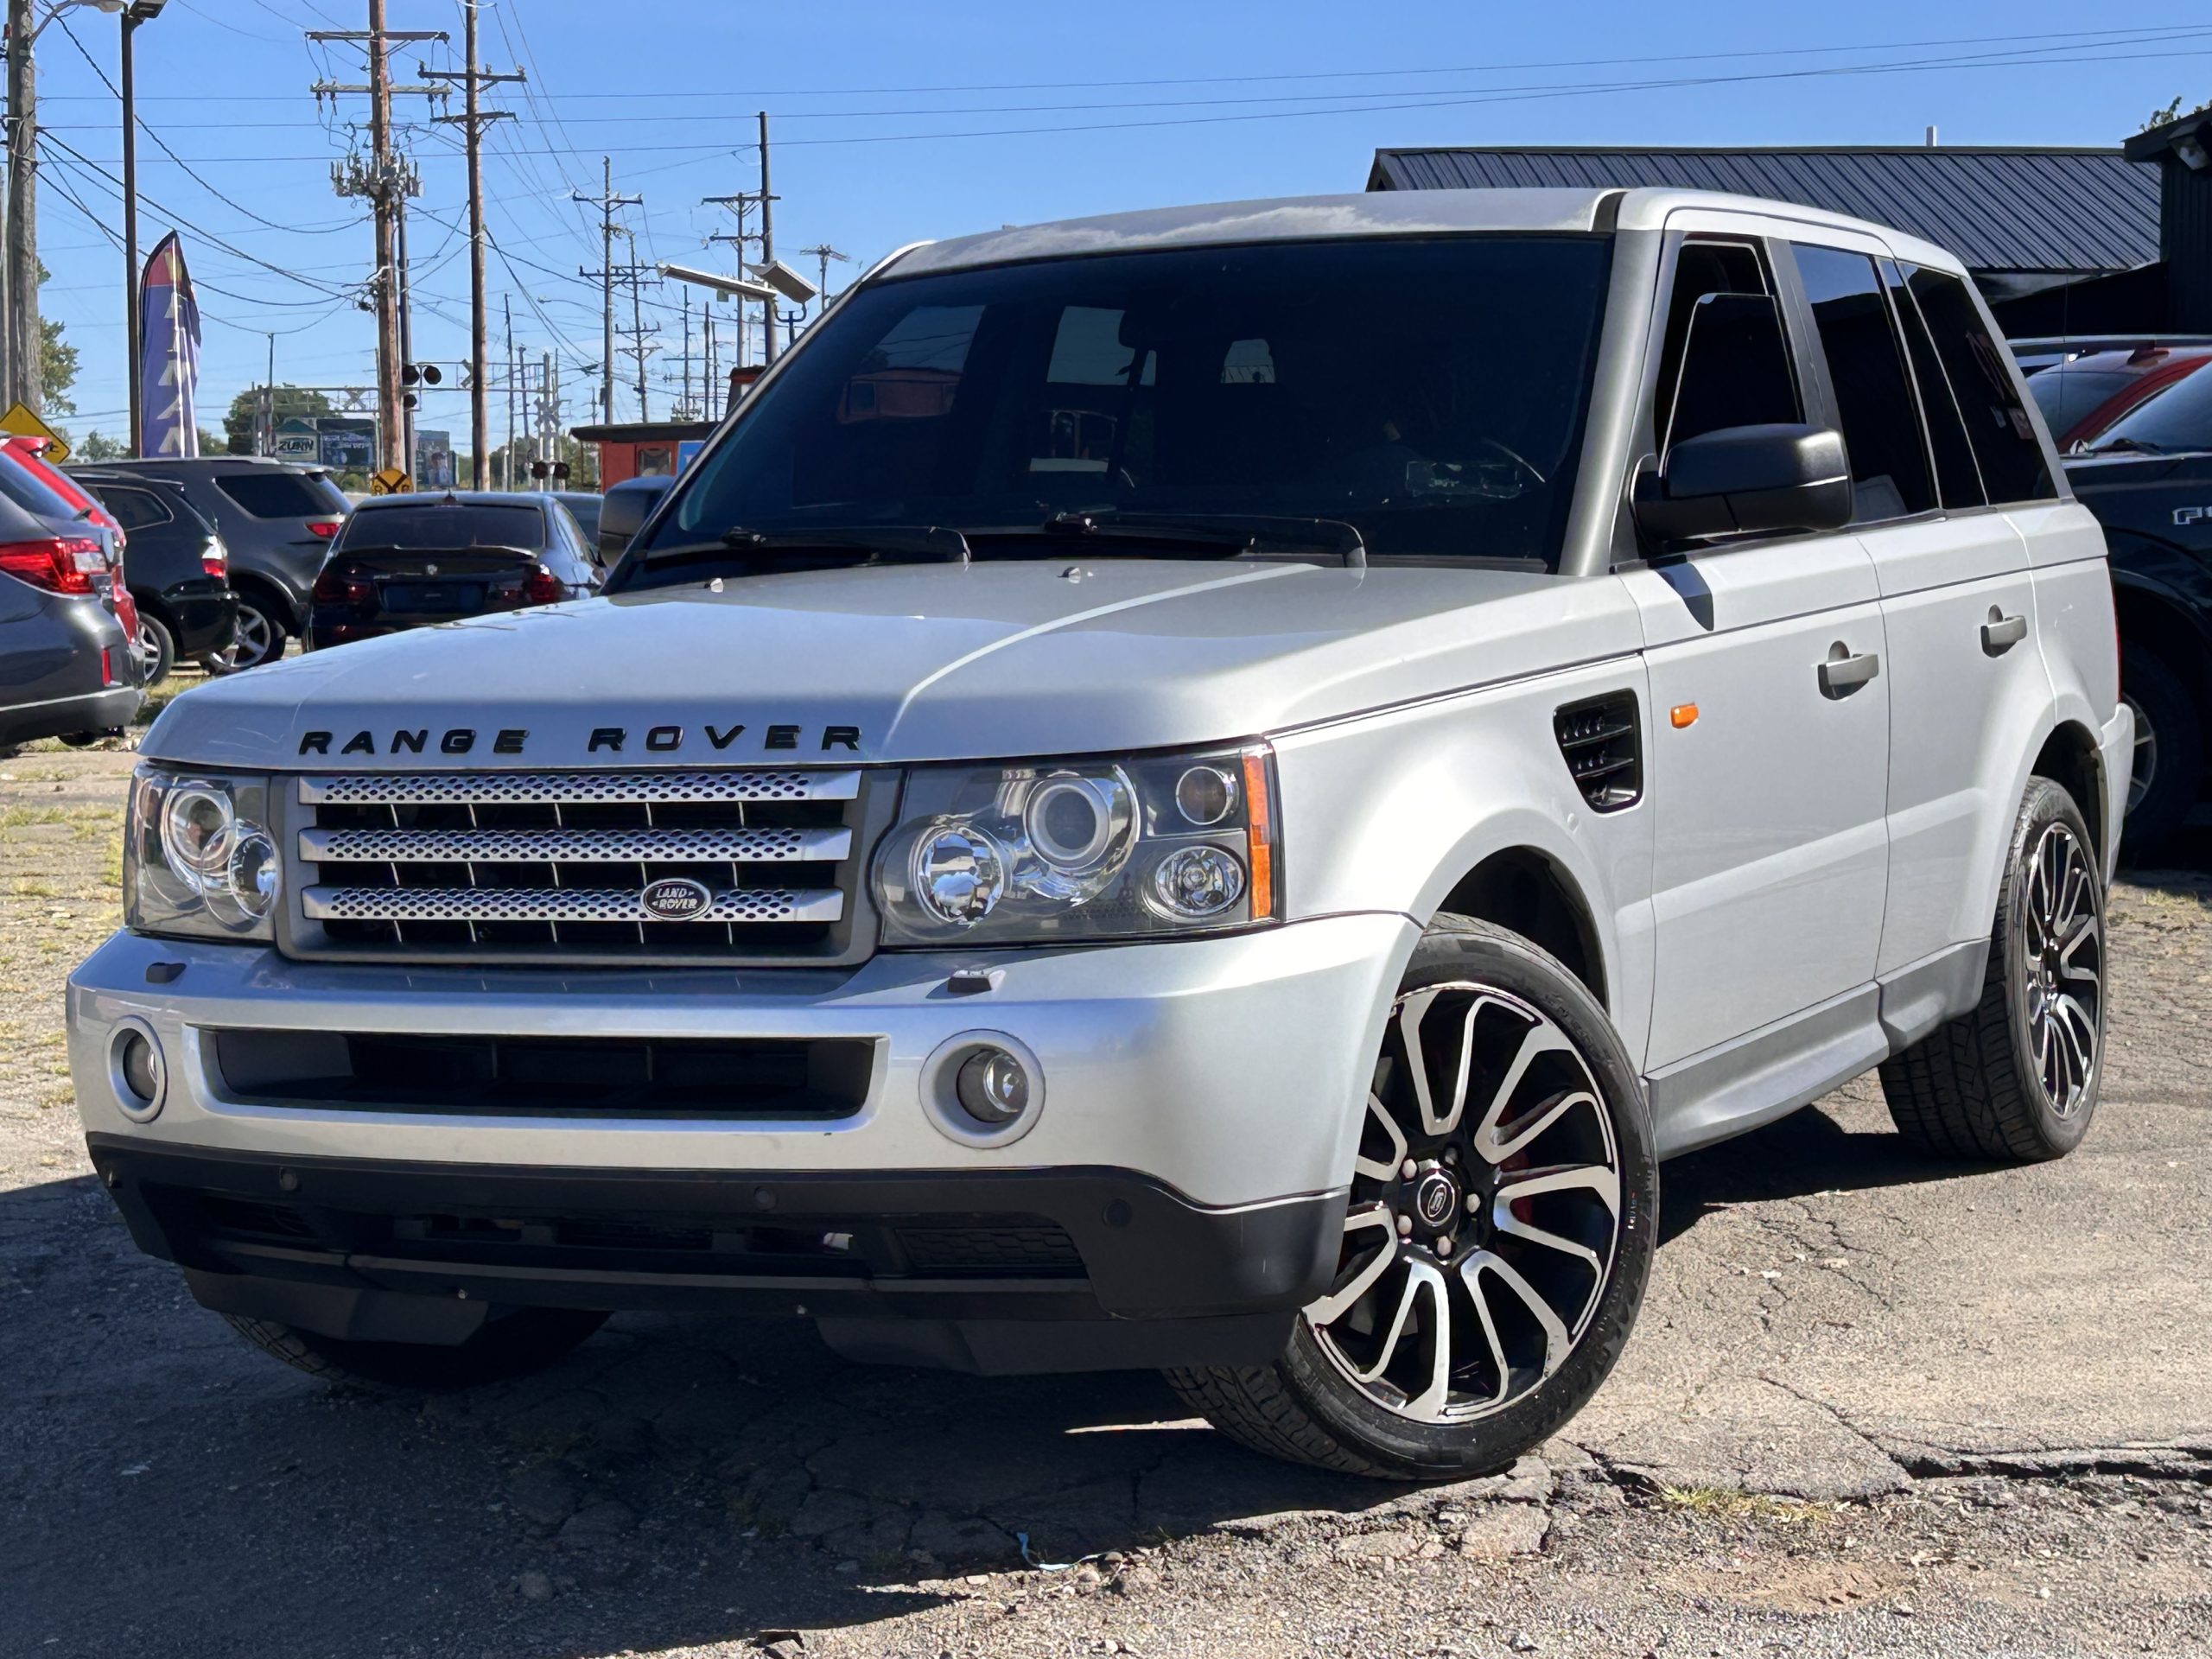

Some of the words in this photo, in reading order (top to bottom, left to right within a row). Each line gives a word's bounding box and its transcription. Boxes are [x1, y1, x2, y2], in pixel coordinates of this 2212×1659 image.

[299, 728, 530, 754] RANGE
[588, 725, 861, 751] ROVER
[656, 887, 688, 898] LAND
[658, 899, 698, 909] ROVER
